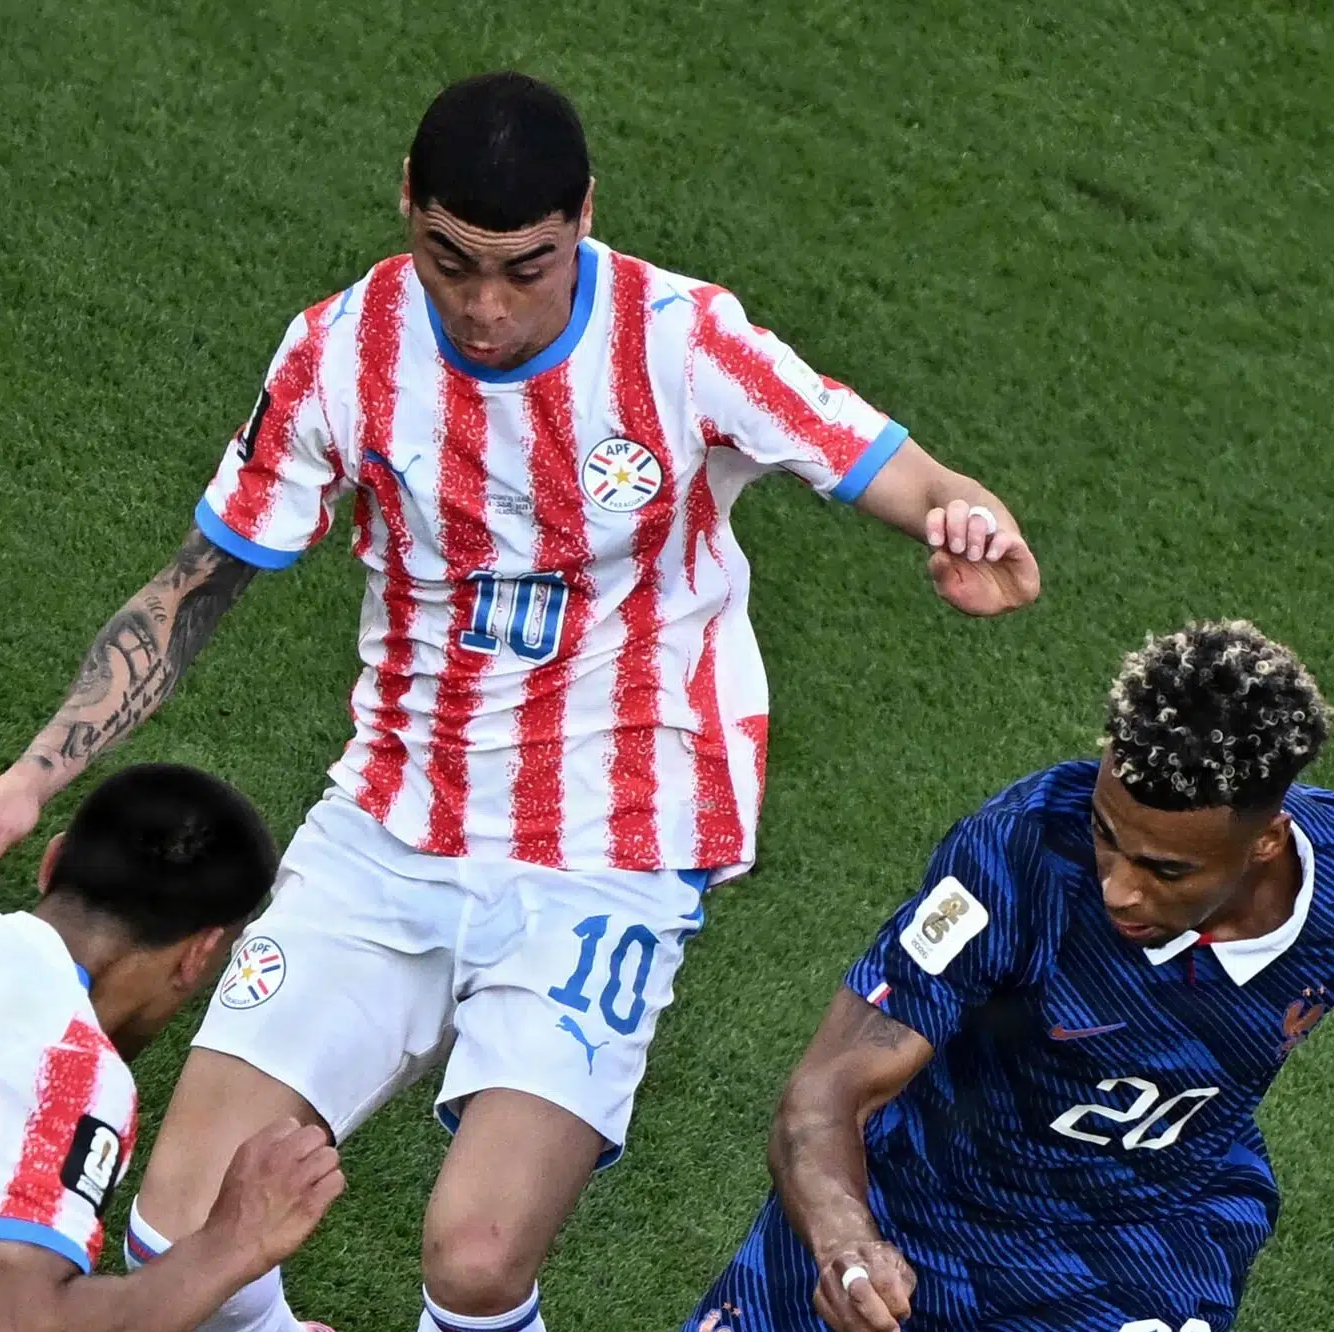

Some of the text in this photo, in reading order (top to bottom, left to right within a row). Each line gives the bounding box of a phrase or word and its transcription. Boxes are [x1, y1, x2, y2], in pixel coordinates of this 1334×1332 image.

[606, 443, 631, 456] APF
[459, 568, 569, 665] 10
[547, 914, 660, 1036] 10
[1049, 1077, 1220, 1150] 20
